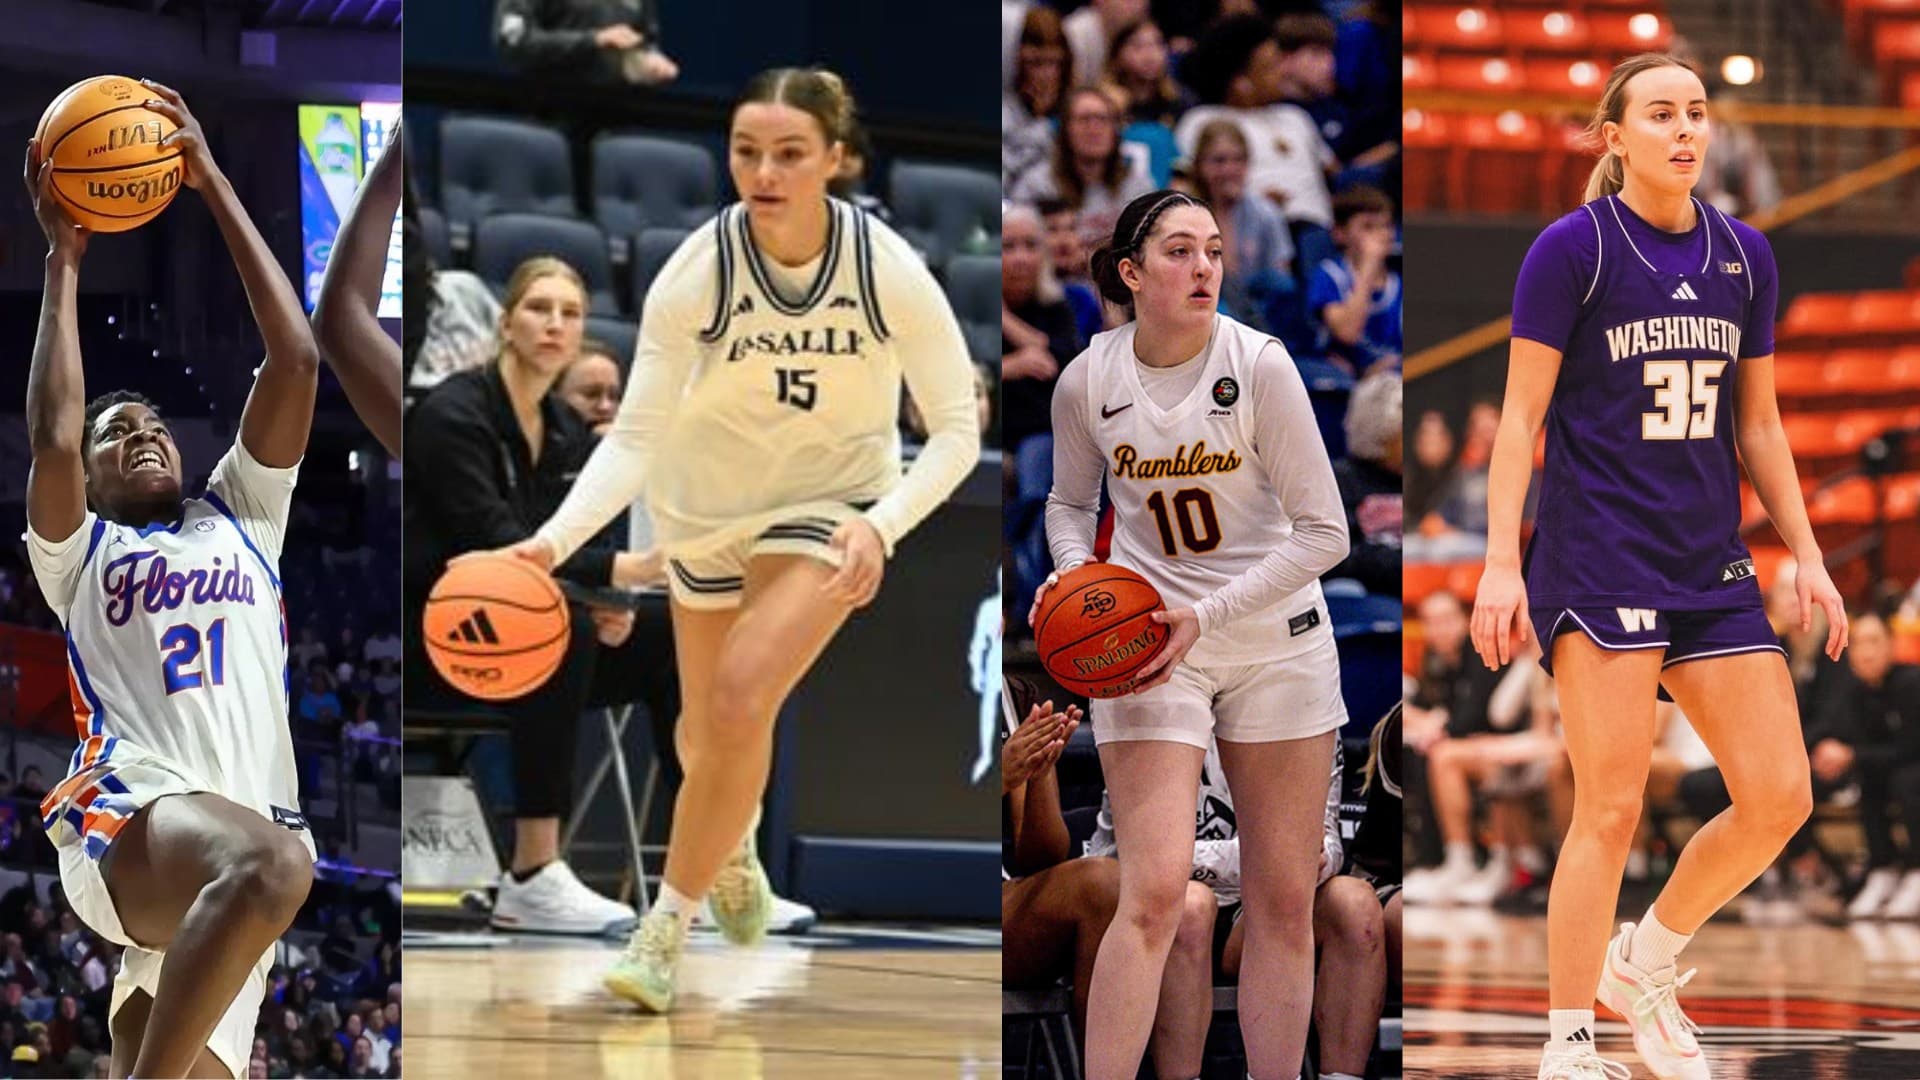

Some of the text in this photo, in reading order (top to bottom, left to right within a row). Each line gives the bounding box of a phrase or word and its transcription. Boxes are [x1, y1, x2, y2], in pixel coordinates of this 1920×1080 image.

[87, 165, 180, 203] Wilson
[774, 367, 818, 412] 15
[1641, 359, 1729, 441] 35
[1112, 439, 1242, 480] Ramblers
[1145, 486, 1223, 557] 10
[103, 549, 256, 628] Florida
[1615, 606, 1657, 633] W
[159, 615, 226, 697] 21
[1071, 624, 1157, 676] SPALDING
